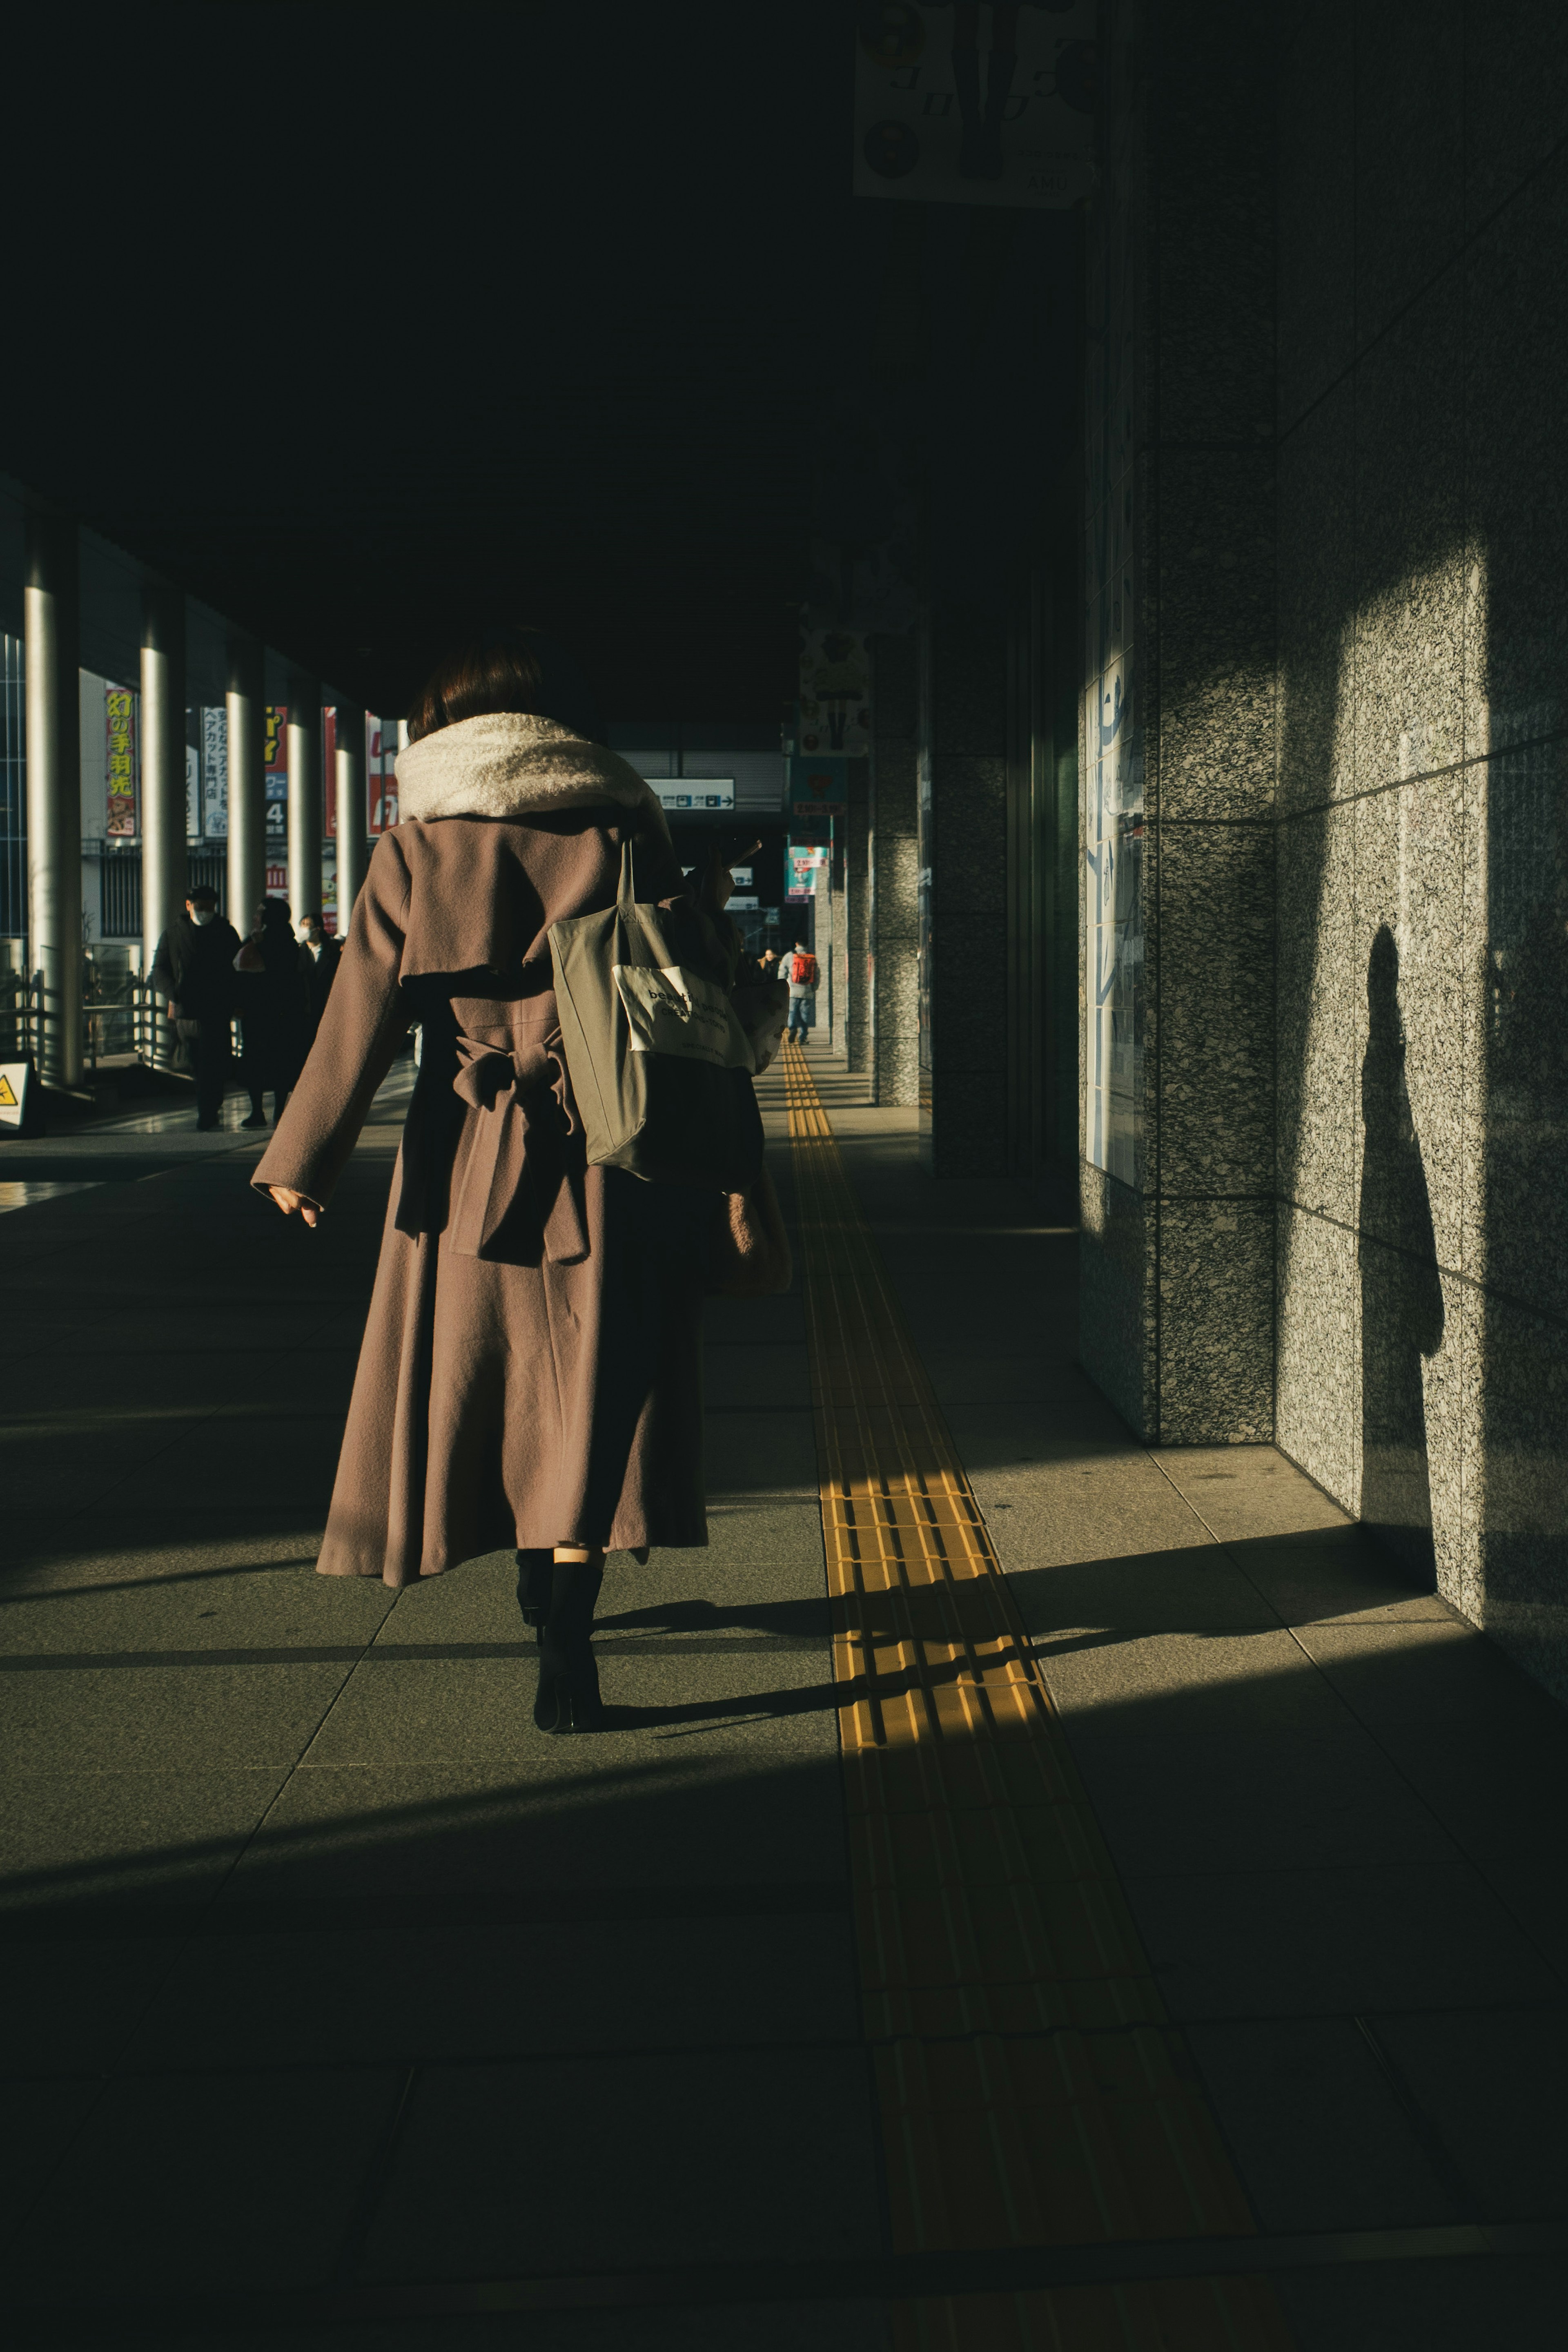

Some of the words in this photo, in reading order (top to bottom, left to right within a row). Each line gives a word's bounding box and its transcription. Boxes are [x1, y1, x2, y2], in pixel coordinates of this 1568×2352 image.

[1027, 176, 1067, 191] AMU
[107, 693, 133, 796] 幻の手羽先
[205, 711, 217, 800] ヘアカット専門店
[648, 990, 699, 1008] beautiful
